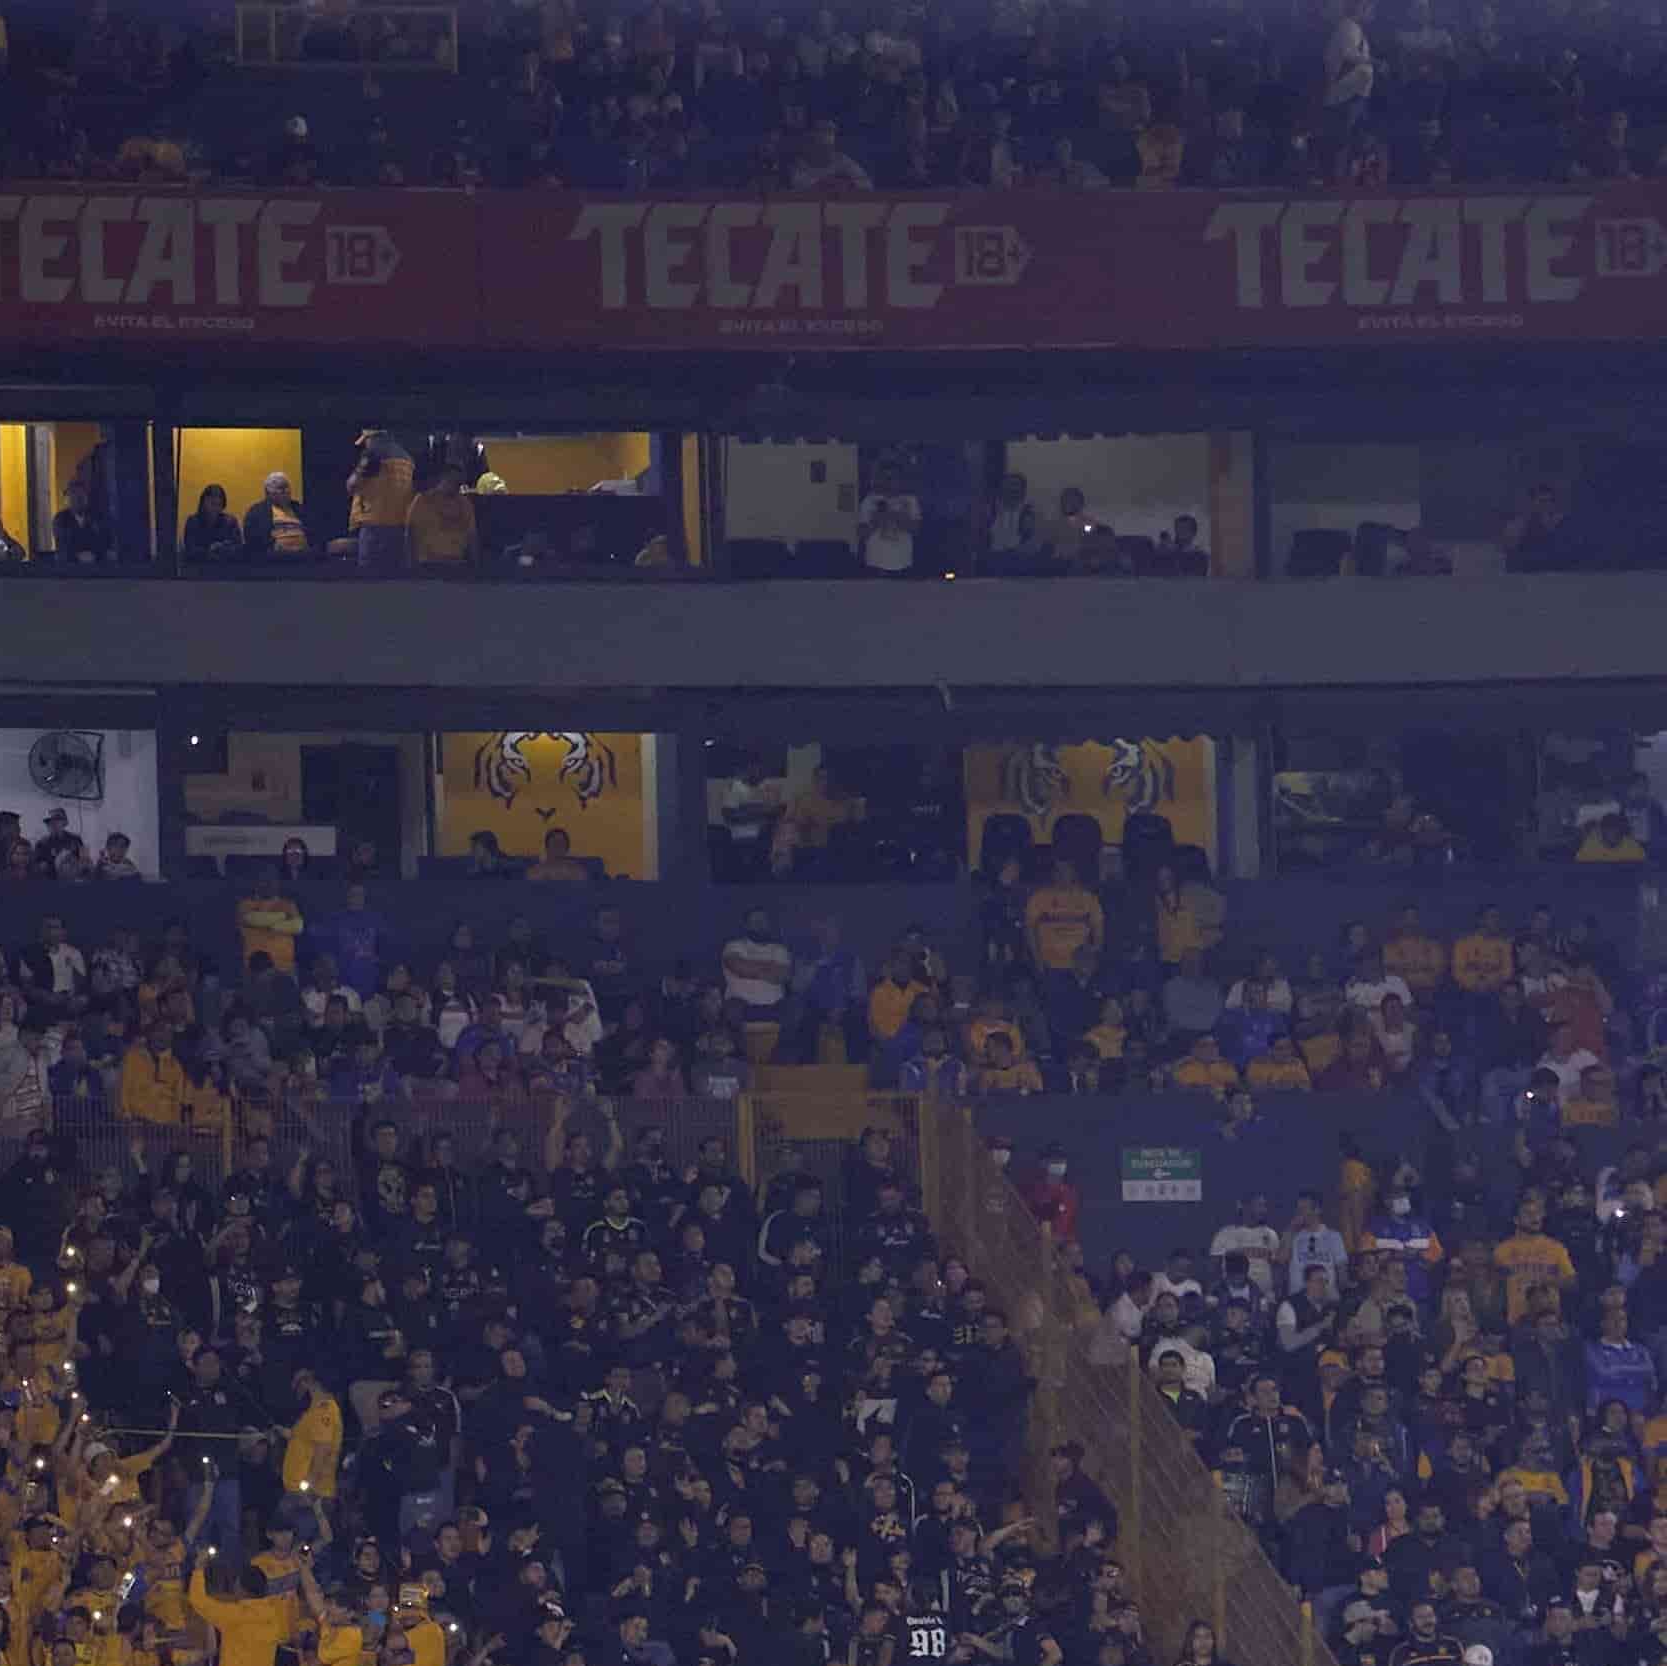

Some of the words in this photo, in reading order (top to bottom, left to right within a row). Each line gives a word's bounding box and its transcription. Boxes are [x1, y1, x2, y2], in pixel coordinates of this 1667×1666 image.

[568, 201, 955, 310] TECATE
[1203, 195, 1595, 309] TECATE
[908, 1629, 946, 1657] 98
